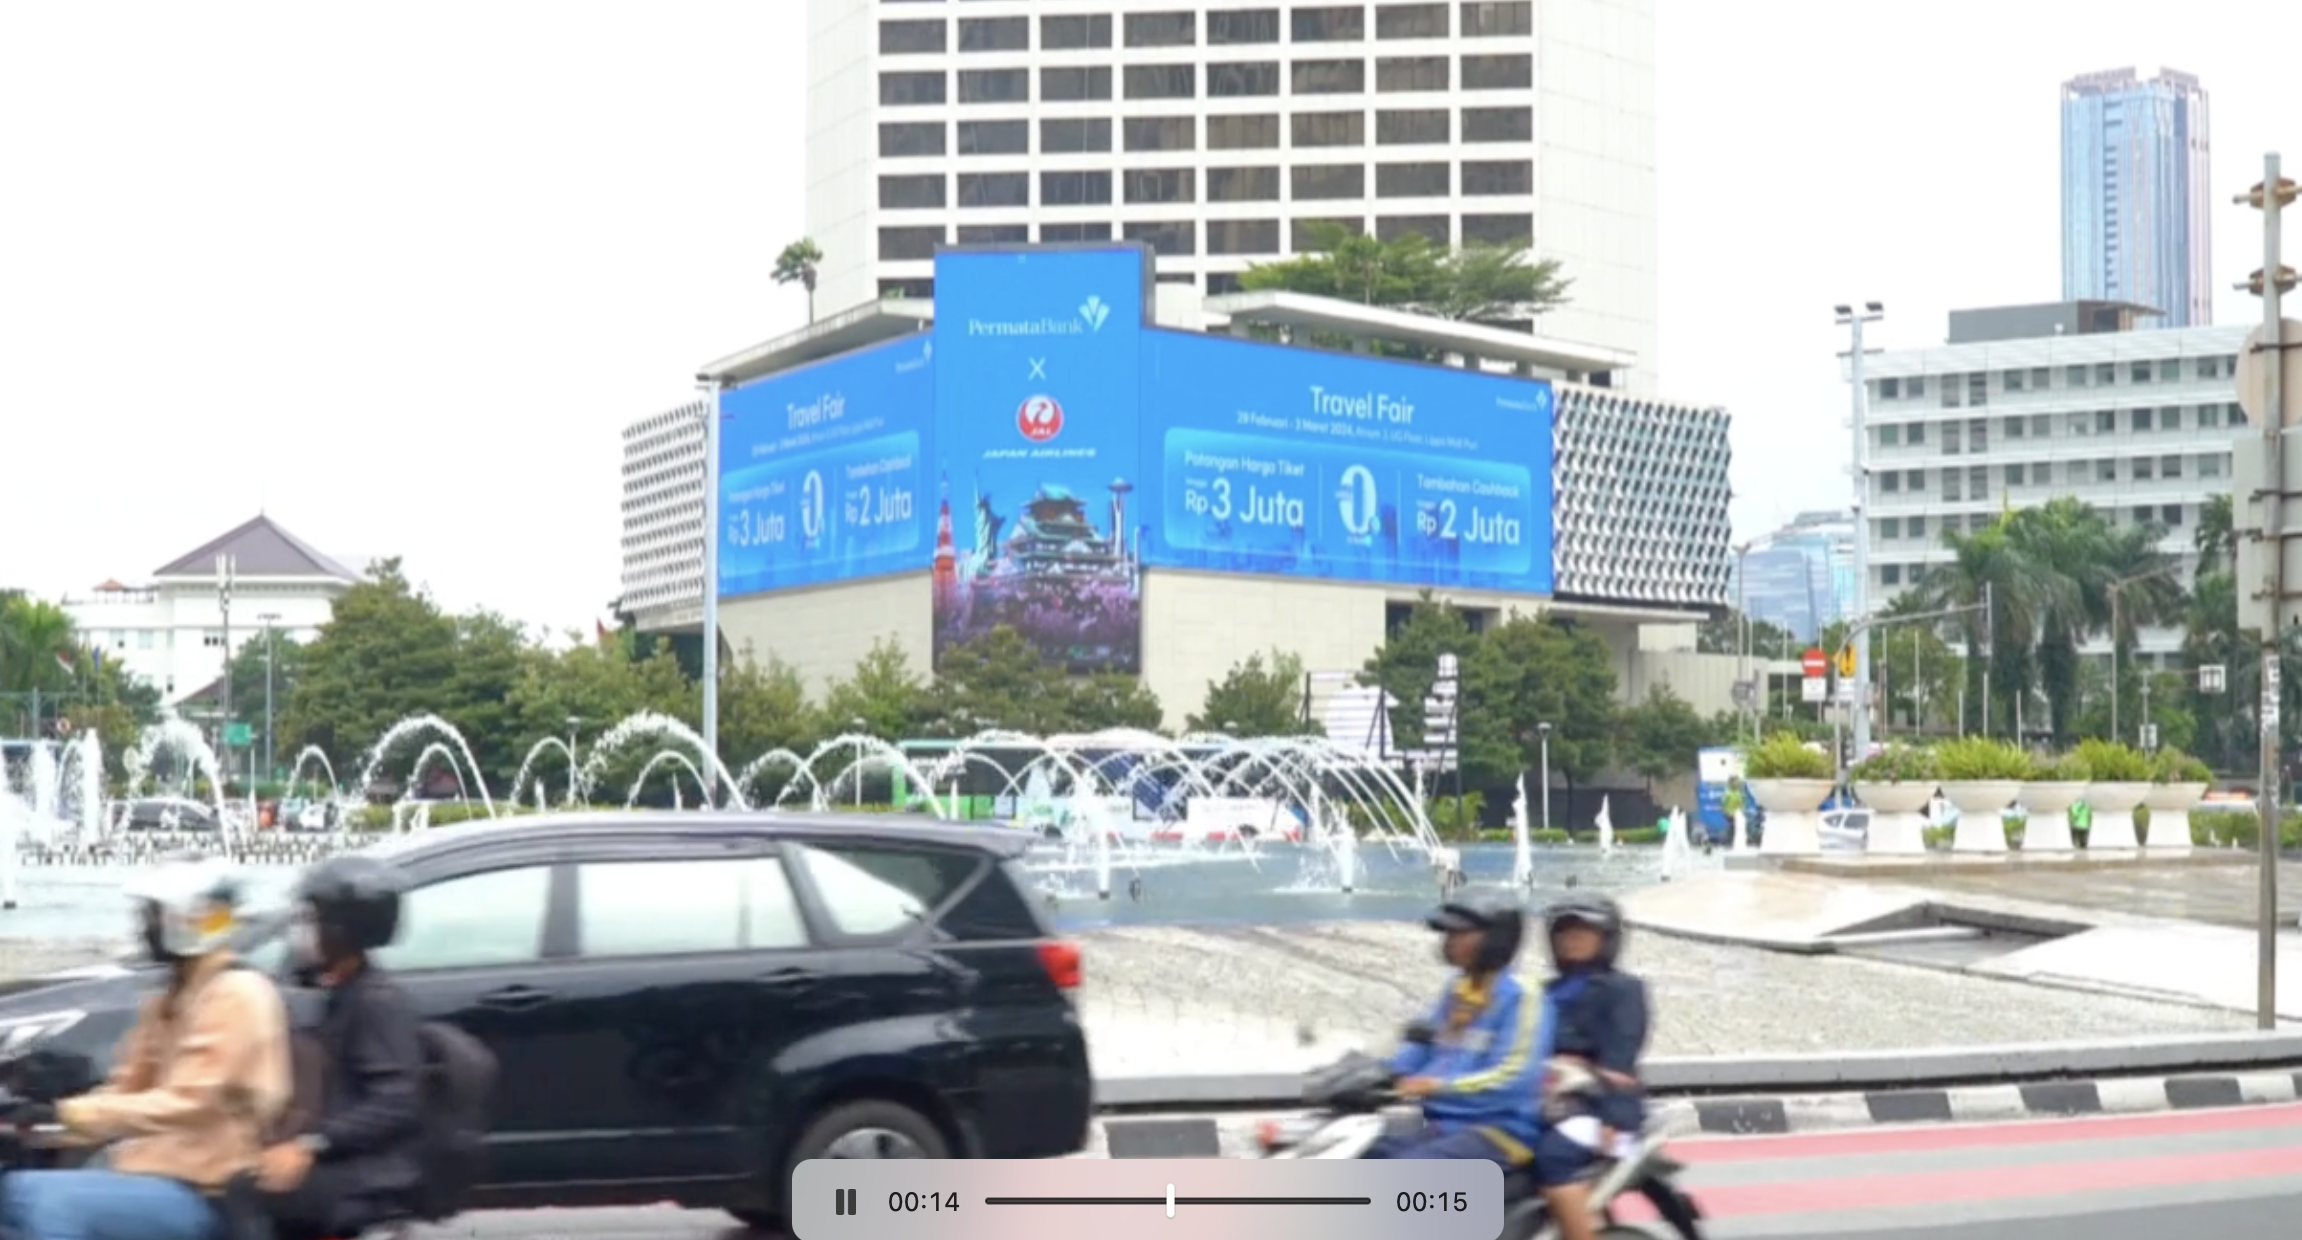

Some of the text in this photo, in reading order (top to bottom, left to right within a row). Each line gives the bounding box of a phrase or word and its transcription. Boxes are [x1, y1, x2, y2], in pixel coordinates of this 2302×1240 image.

[967, 317, 1083, 337] PermataBank
[786, 396, 821, 430] Travel
[822, 390, 846, 421] Fair
[1309, 384, 1415, 424] Travel Fair
[982, 446, 1097, 459] JAPAN AIRLINES
[1184, 450, 1305, 477] Potongan Harga Tiket
[1184, 476, 1305, 527] Rp 3 Juta
[1416, 473, 1470, 494] Tambahan
[859, 485, 871, 526] 2
[873, 486, 912, 525] Juta
[1416, 497, 1521, 546] Rp 2 Juta
[740, 509, 750, 547] 3
[751, 509, 785, 546] Juta
